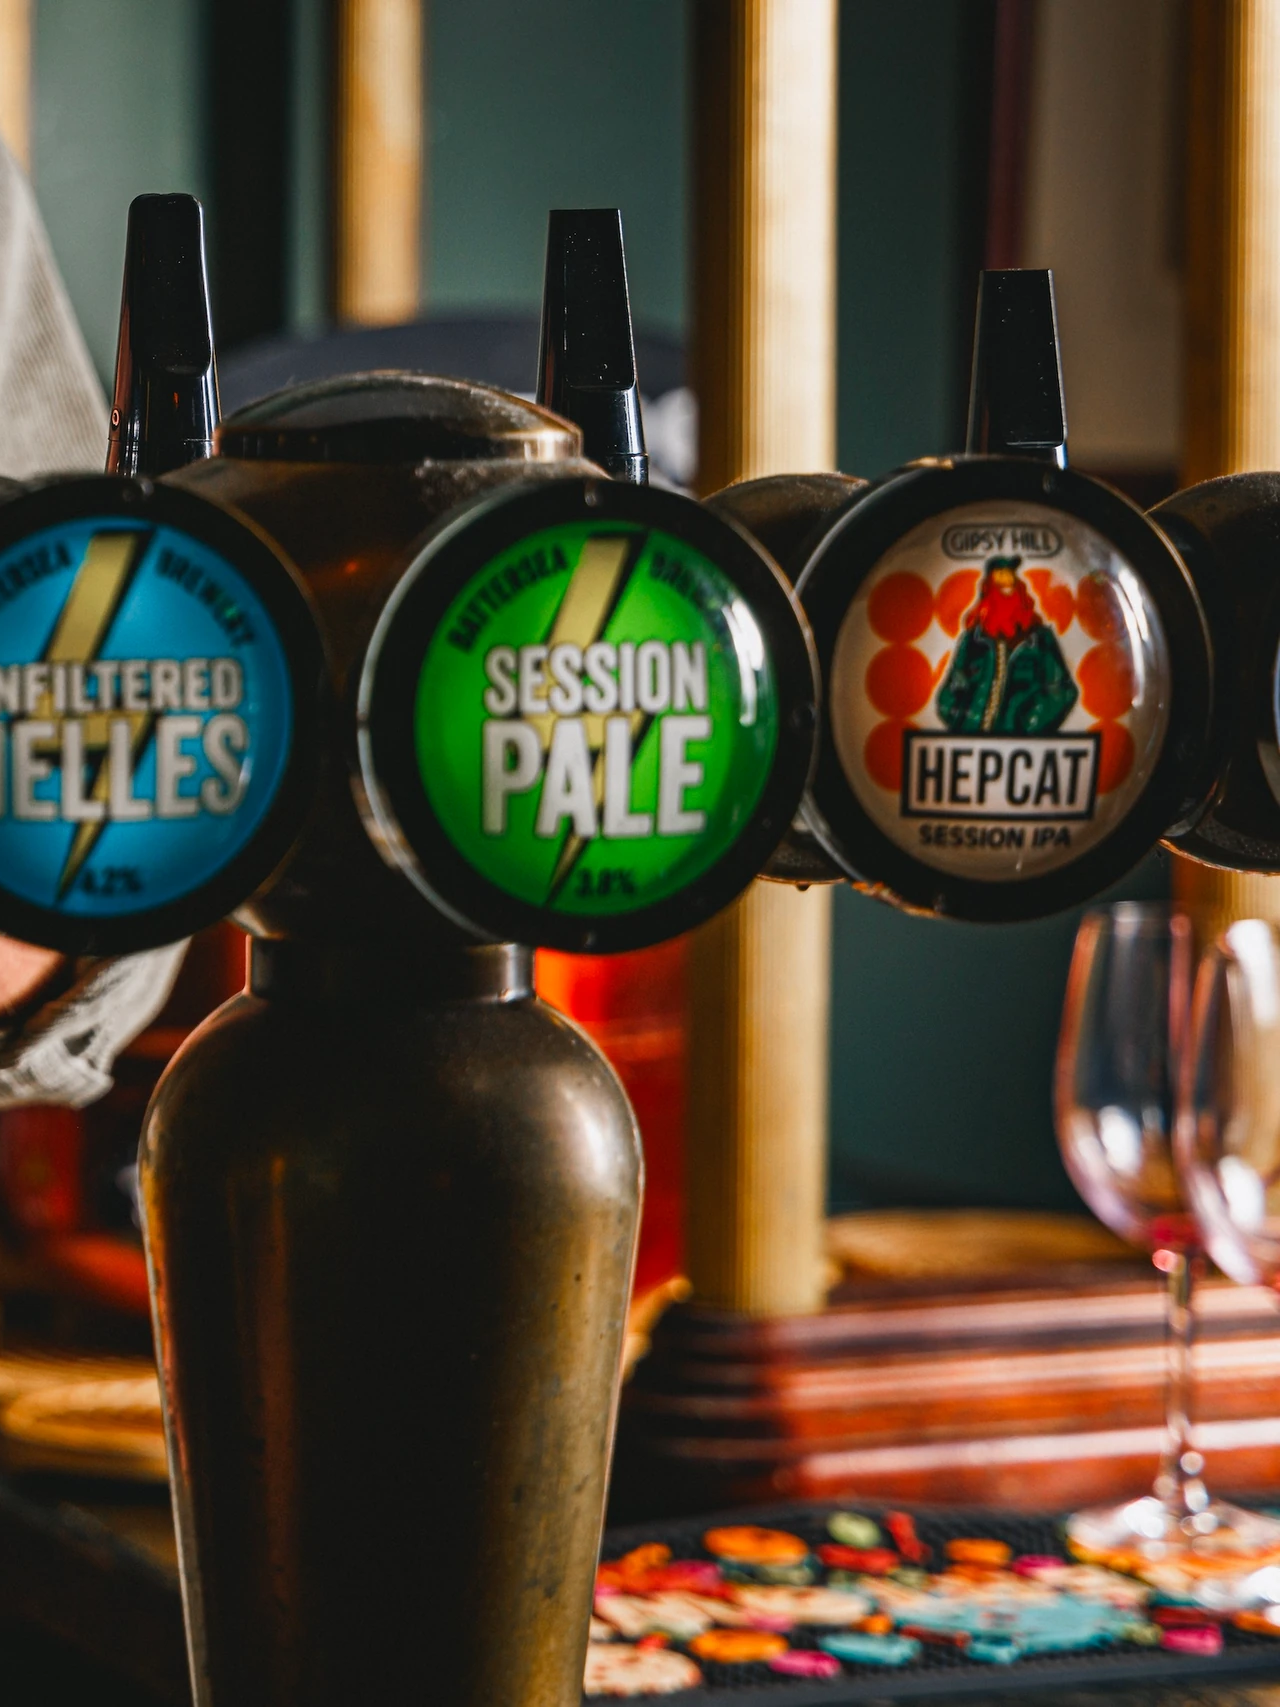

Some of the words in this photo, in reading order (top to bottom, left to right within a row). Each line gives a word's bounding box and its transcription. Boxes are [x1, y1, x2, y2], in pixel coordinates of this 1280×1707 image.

[950, 529, 1004, 552] GIPSY
[1011, 529, 1053, 552] HILL
[447, 543, 568, 654] BATTERSEA
[483, 640, 709, 717] SESSION
[481, 715, 713, 839] PALE
[918, 746, 1090, 808] HEPCAT
[919, 825, 1023, 849] SESSION
[1032, 825, 1071, 848] IPA
